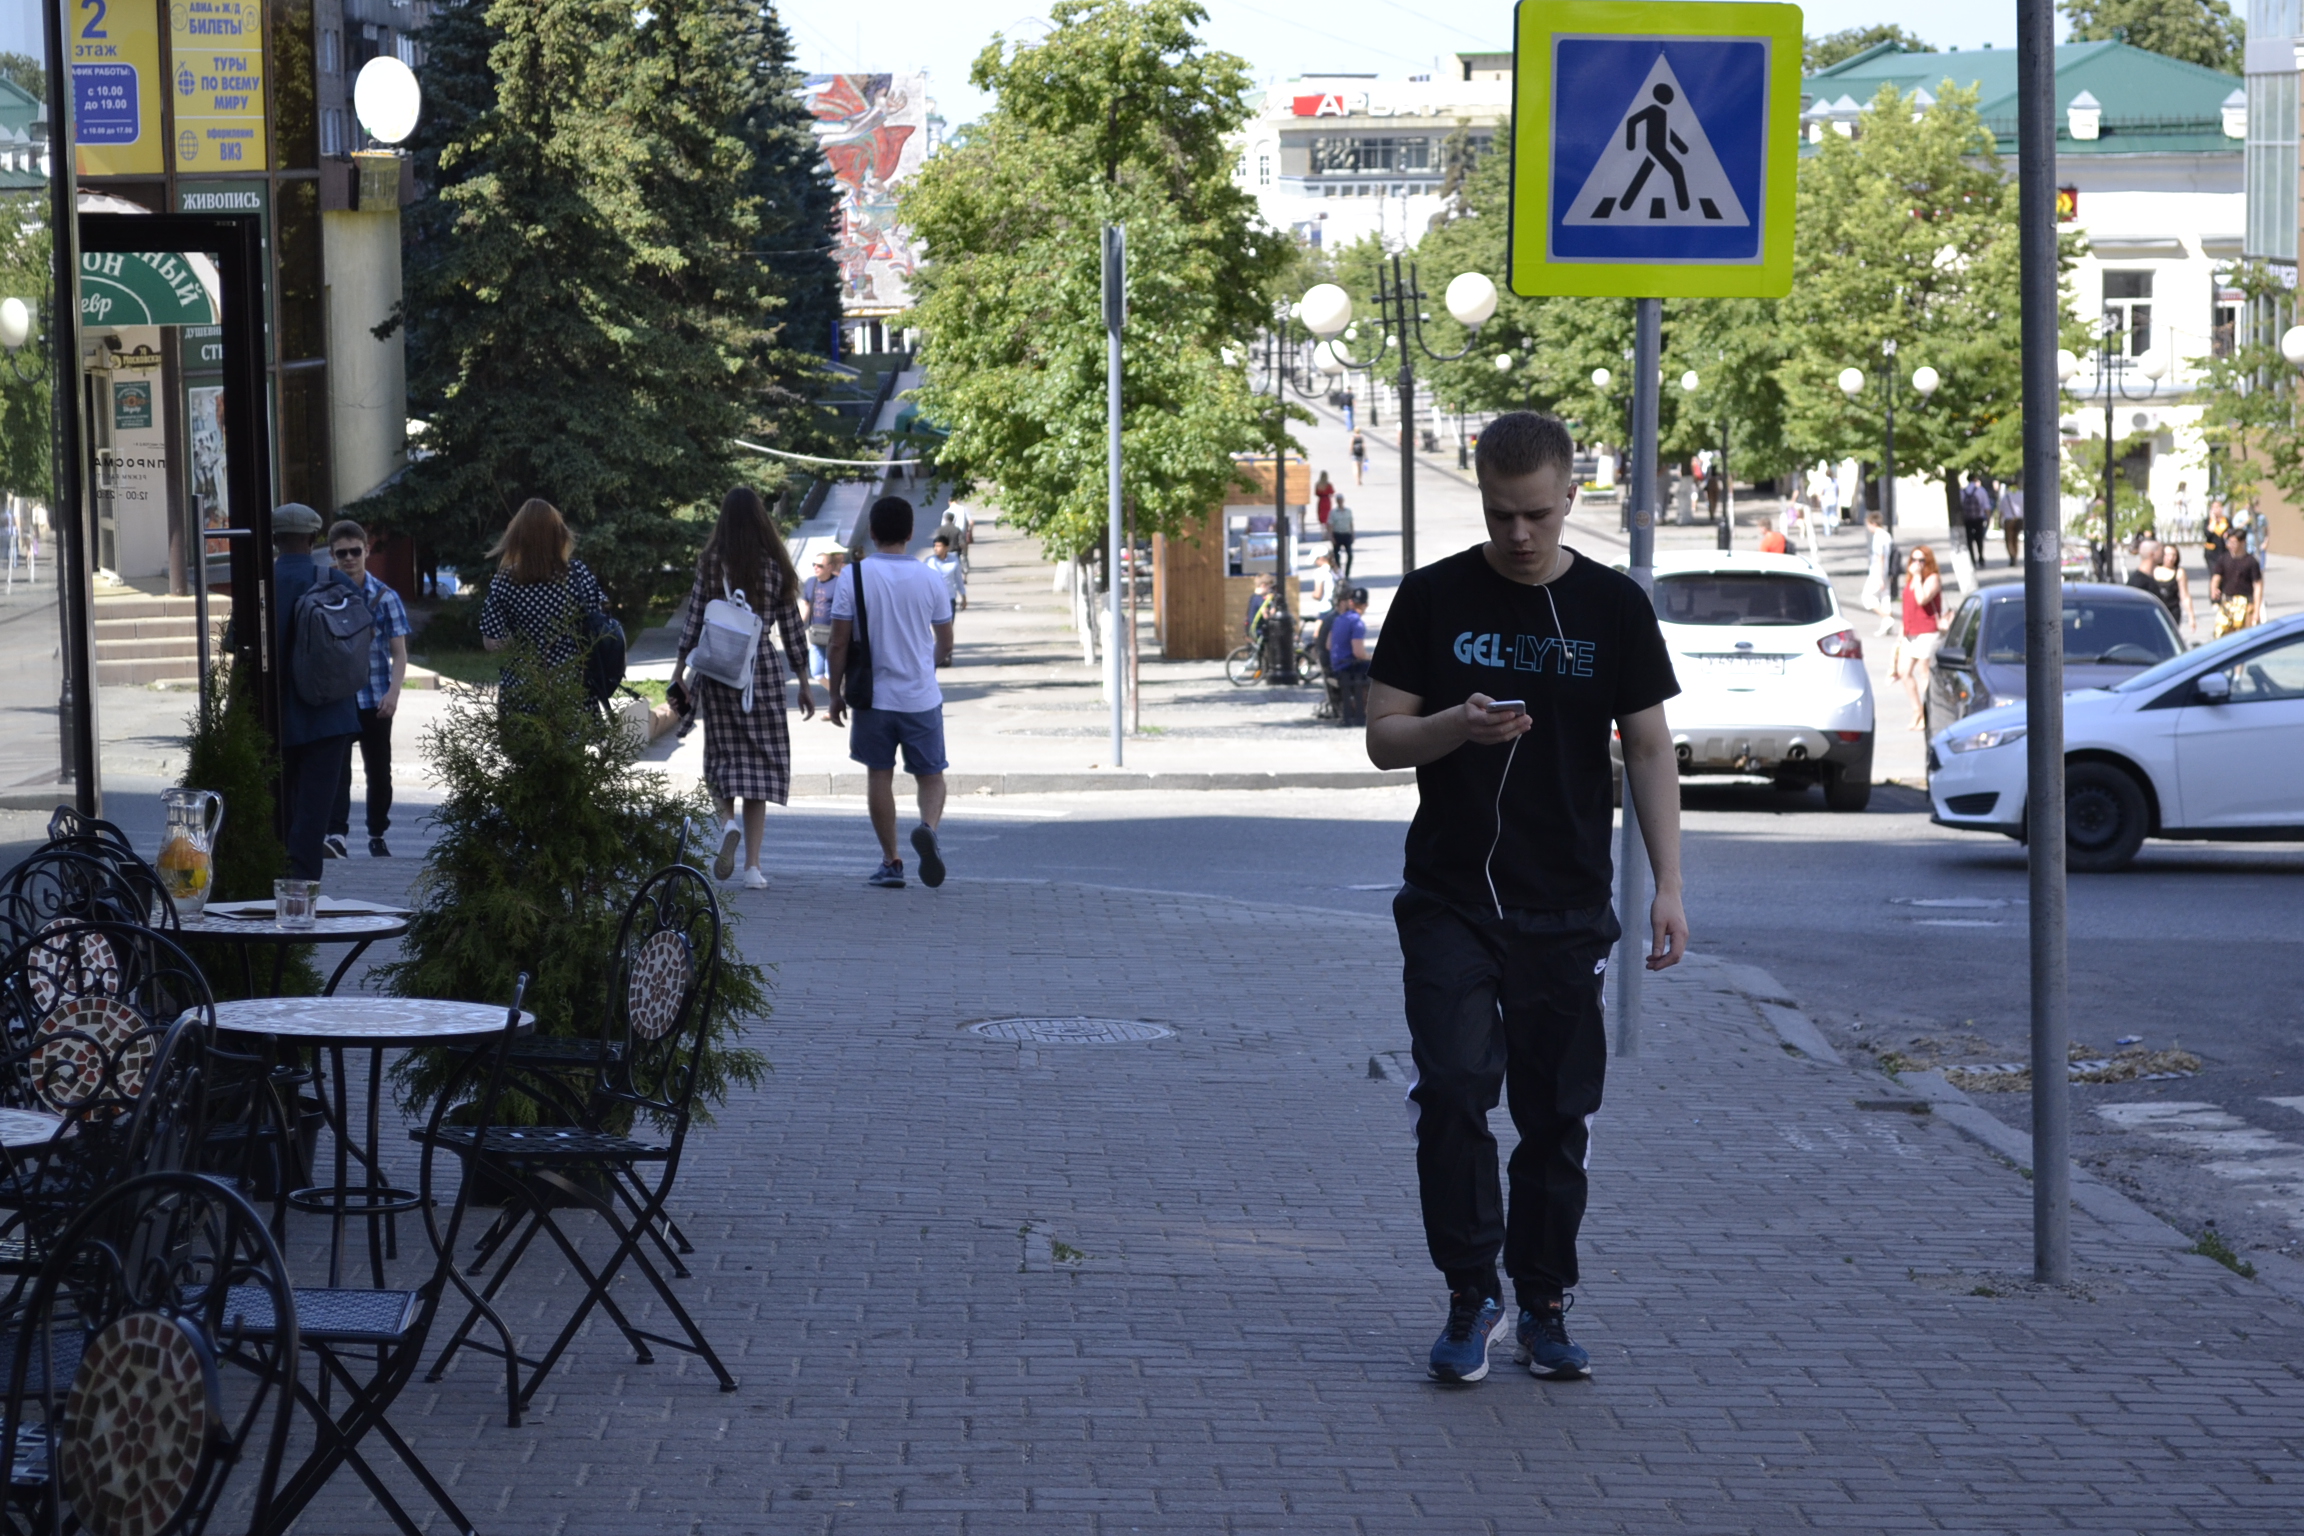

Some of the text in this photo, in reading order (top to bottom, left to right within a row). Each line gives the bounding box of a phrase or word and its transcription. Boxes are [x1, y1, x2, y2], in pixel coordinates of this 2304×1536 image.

[189, 2, 213, 13] АВИА
[222, 3, 241, 15] Ж/Д
[81, 0, 108, 39] 2
[189, 18, 242, 35] БИЛЕТЫ
[75, 44, 118, 57] этаж
[213, 57, 247, 72] ТУРЫ
[87, 86, 123, 96] с 10.00
[201, 76, 260, 91] ПО ВСЕМУ
[84, 99, 127, 111] до 19.00
[214, 95, 249, 110] МИРУ
[220, 142, 242, 161] ВИЗ
[183, 192, 260, 210] ЖИВОПИСЬ
[132, 252, 203, 308] НЫЙ
[1453, 631, 1596, 677] GEL-LYTE
